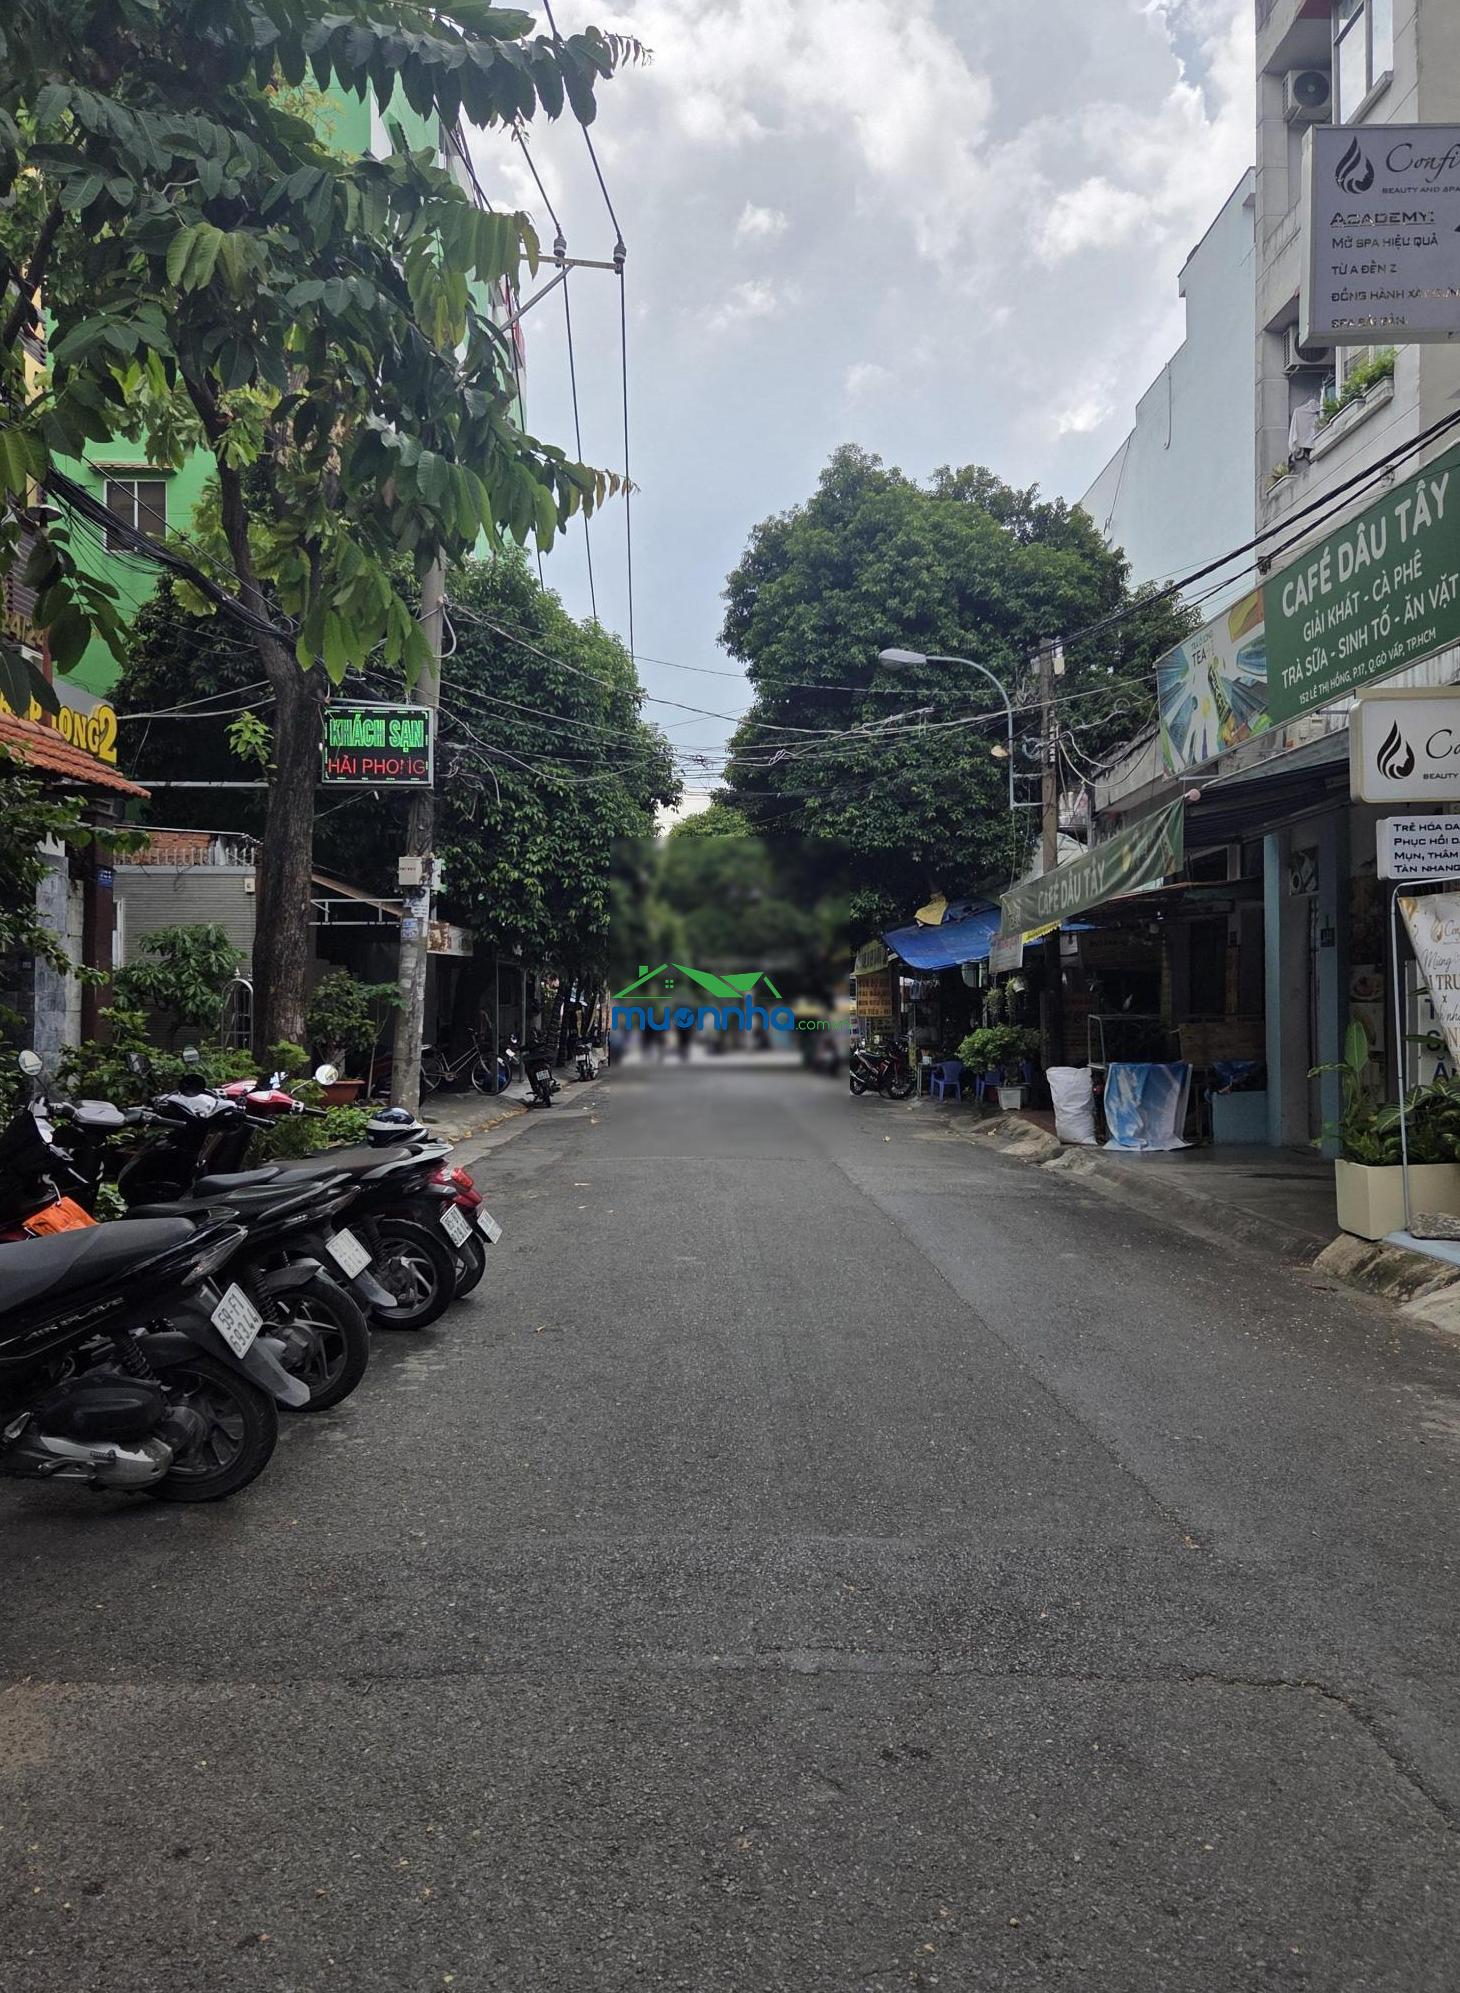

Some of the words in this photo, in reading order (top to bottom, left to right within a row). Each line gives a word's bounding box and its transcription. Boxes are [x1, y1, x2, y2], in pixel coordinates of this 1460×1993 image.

[1382, 187, 1417, 195] BEAUTY
[1350, 265, 1359, 275] A
[1282, 546, 1332, 618] CAFÉ
[1338, 516, 1387, 582] DÂU
[1395, 472, 1449, 543] TÂY
[1303, 610, 1325, 642] GIẢI
[1328, 591, 1360, 630] KHÁT
[1372, 570, 1391, 601] CÀ
[1394, 548, 1423, 590] PHÊ
[1281, 658, 1303, 689] TRÀ
[1338, 625, 1368, 659] SINH
[1371, 604, 1391, 640] TỐ
[1404, 593, 1425, 625] ĂN
[330, 713, 386, 747] KHÁCH
[389, 719, 424, 753] SẠN
[328, 755, 356, 774] HẢI
[1423, 772, 1458, 780] BEAUTY
[1394, 837, 1426, 848] PHỤC
[1394, 864, 1418, 873] TÀN
[1061, 870, 1080, 910] DÂU
